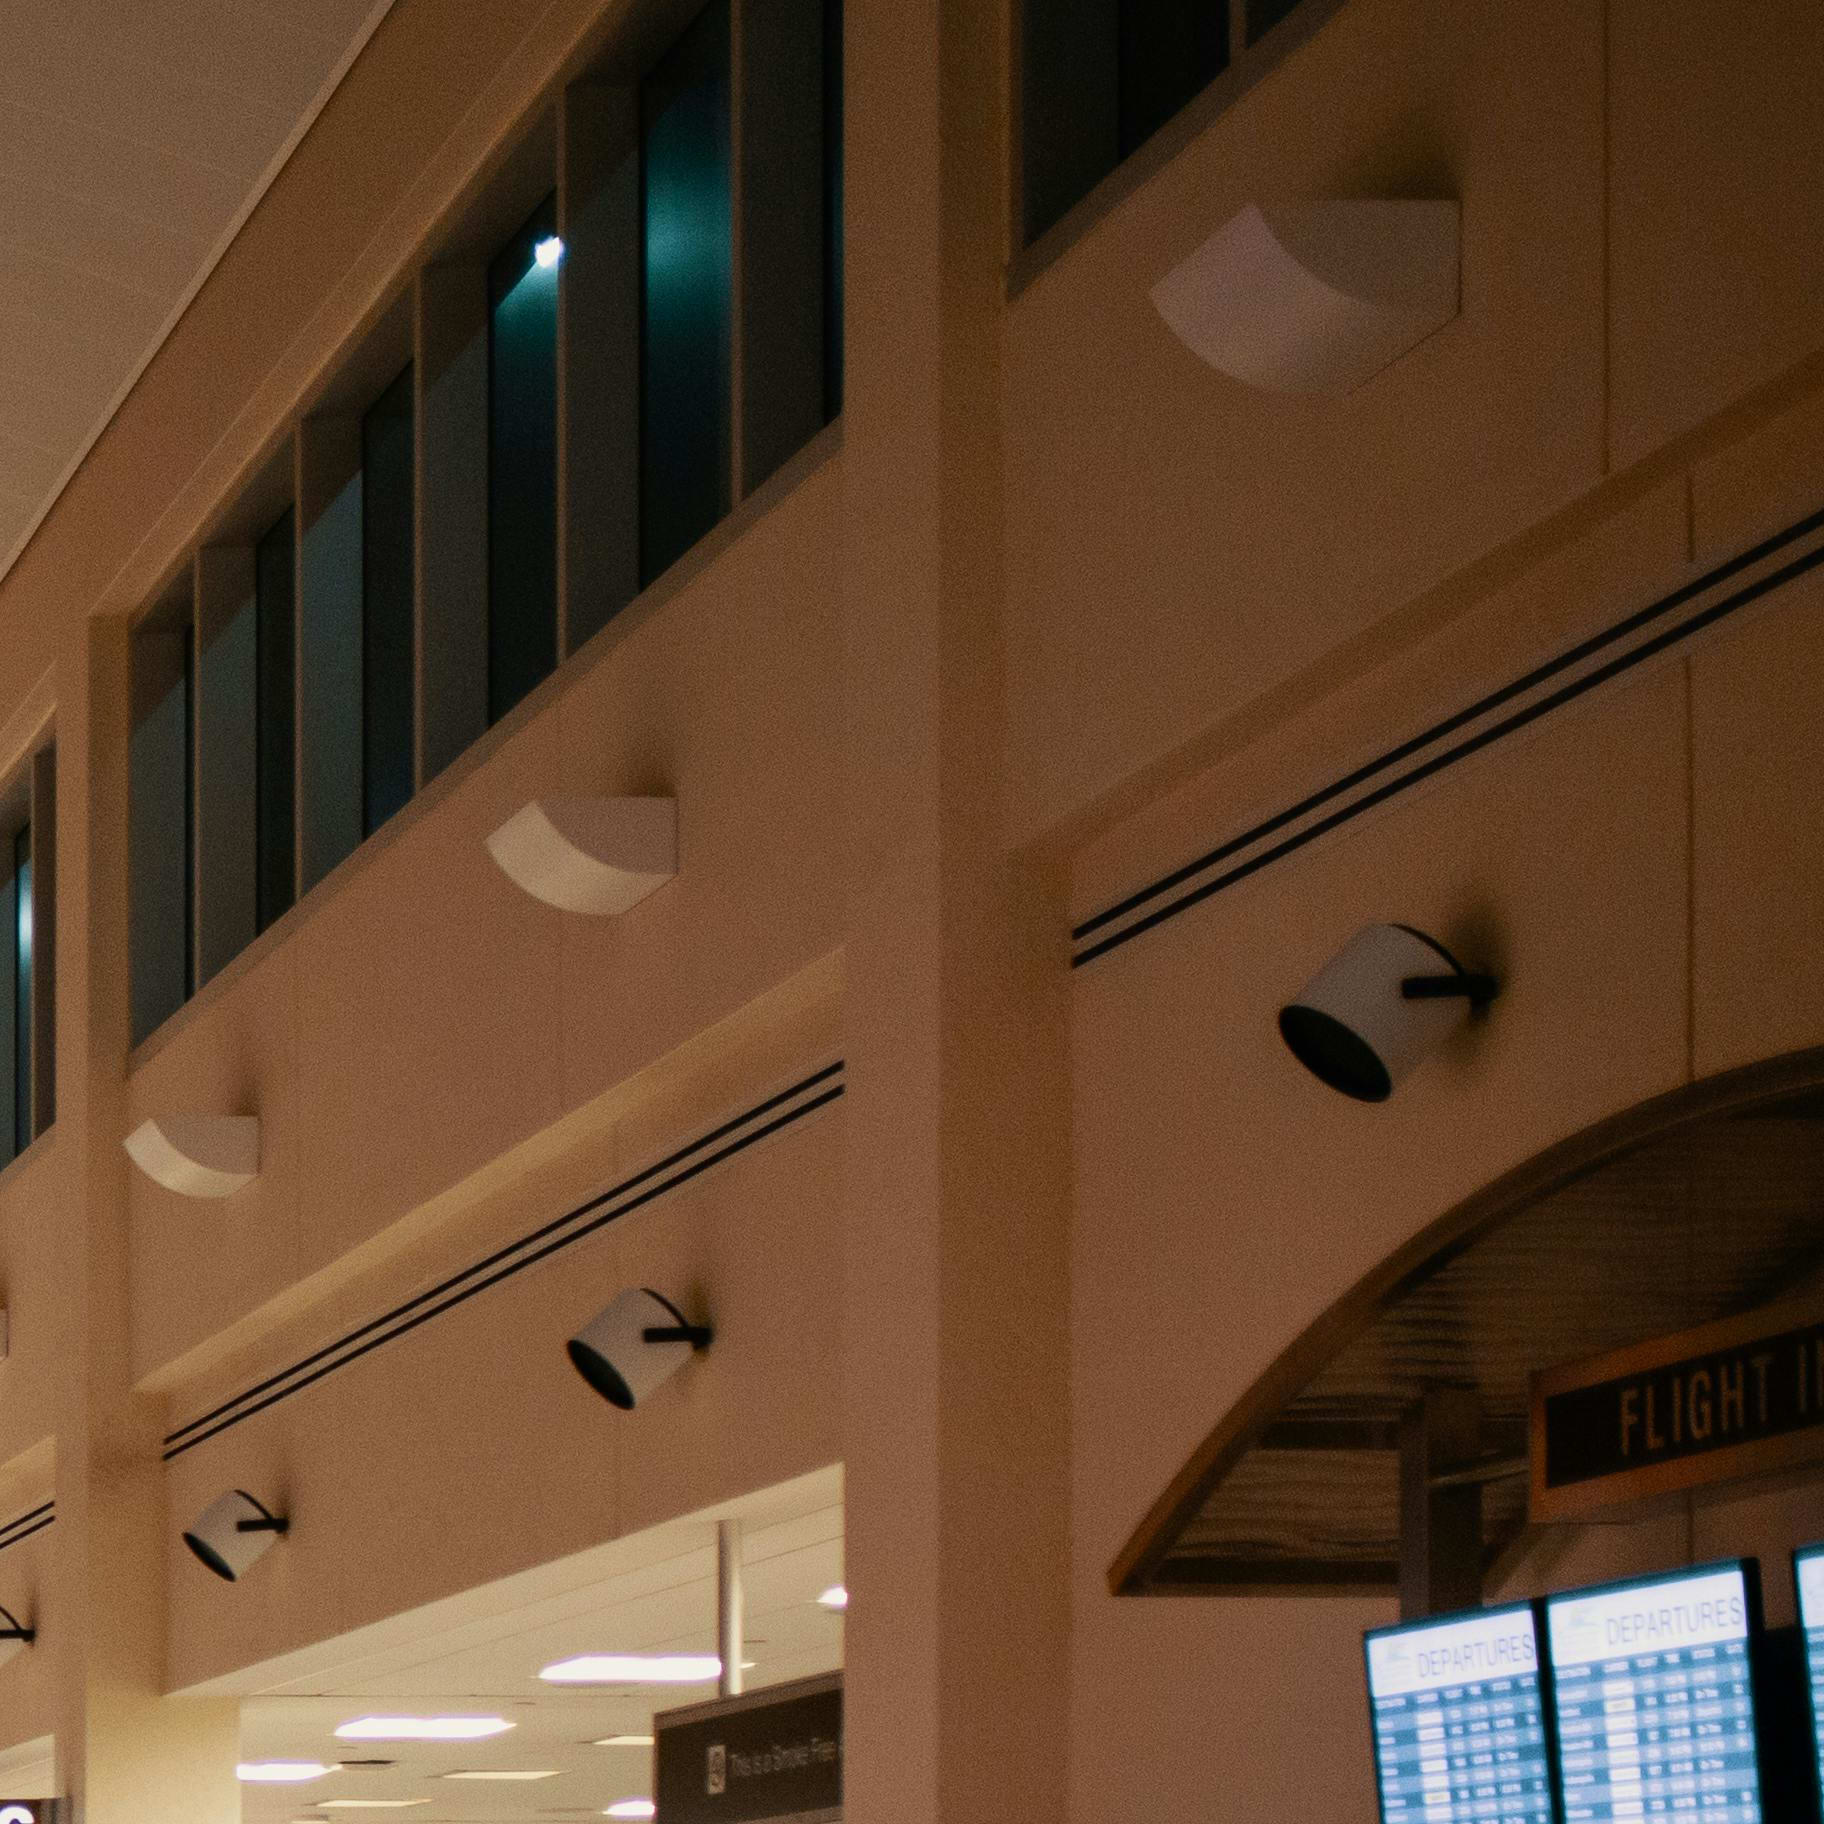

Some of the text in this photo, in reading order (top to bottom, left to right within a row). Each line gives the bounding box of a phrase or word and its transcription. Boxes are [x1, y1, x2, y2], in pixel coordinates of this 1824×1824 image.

[1617, 1353, 1774, 1457] FLIGHT
[1607, 1595, 1743, 1646] DEPARTURES
[1417, 1633, 1535, 1679] DEPARTURES
